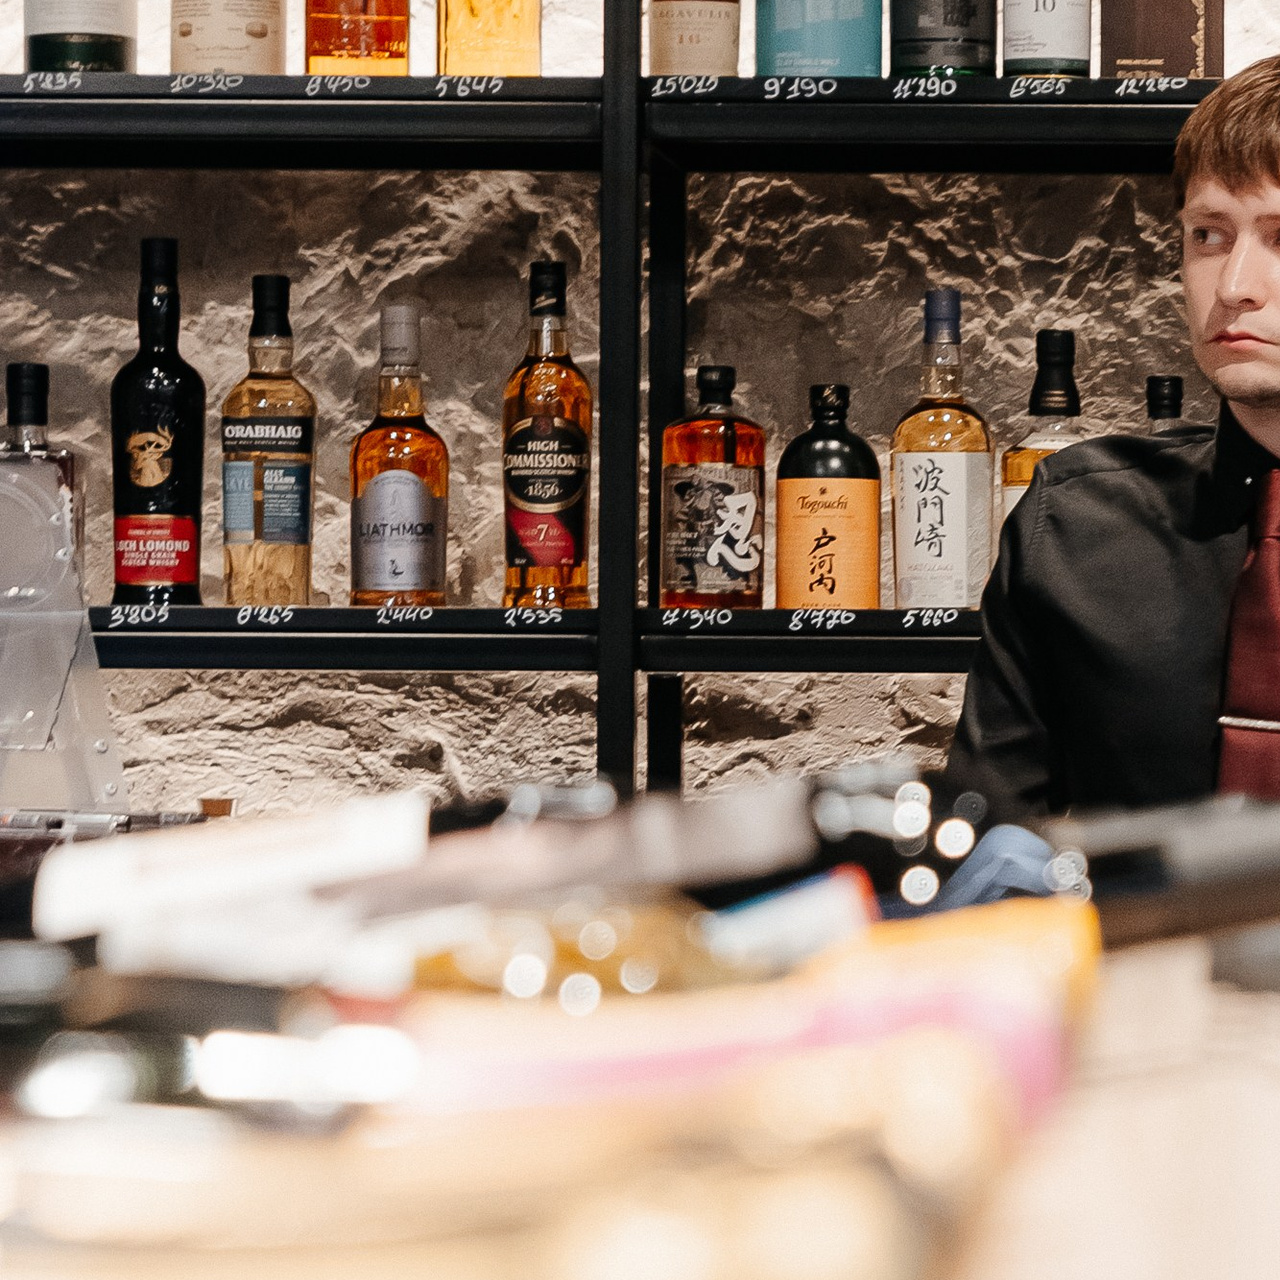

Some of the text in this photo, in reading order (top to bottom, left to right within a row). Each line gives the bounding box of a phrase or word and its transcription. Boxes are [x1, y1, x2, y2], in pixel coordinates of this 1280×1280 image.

[170, 75, 243, 93] 10'320
[435, 75, 504, 97] 5'645
[651, 75, 719, 97] 15'015
[764, 77, 837, 98] 9'190
[893, 77, 957, 98] 11'290
[224, 424, 303, 439] ORABHAIG
[526, 440, 560, 452] HIGH
[796, 495, 848, 514] Togouchi
[537, 523, 550, 543] 7
[138, 539, 191, 553] LOMOND
[108, 605, 170, 628] 3'805
[376, 606, 434, 624] 2'440
[504, 607, 564, 627] 2'535
[901, 608, 959, 627] 5'660
